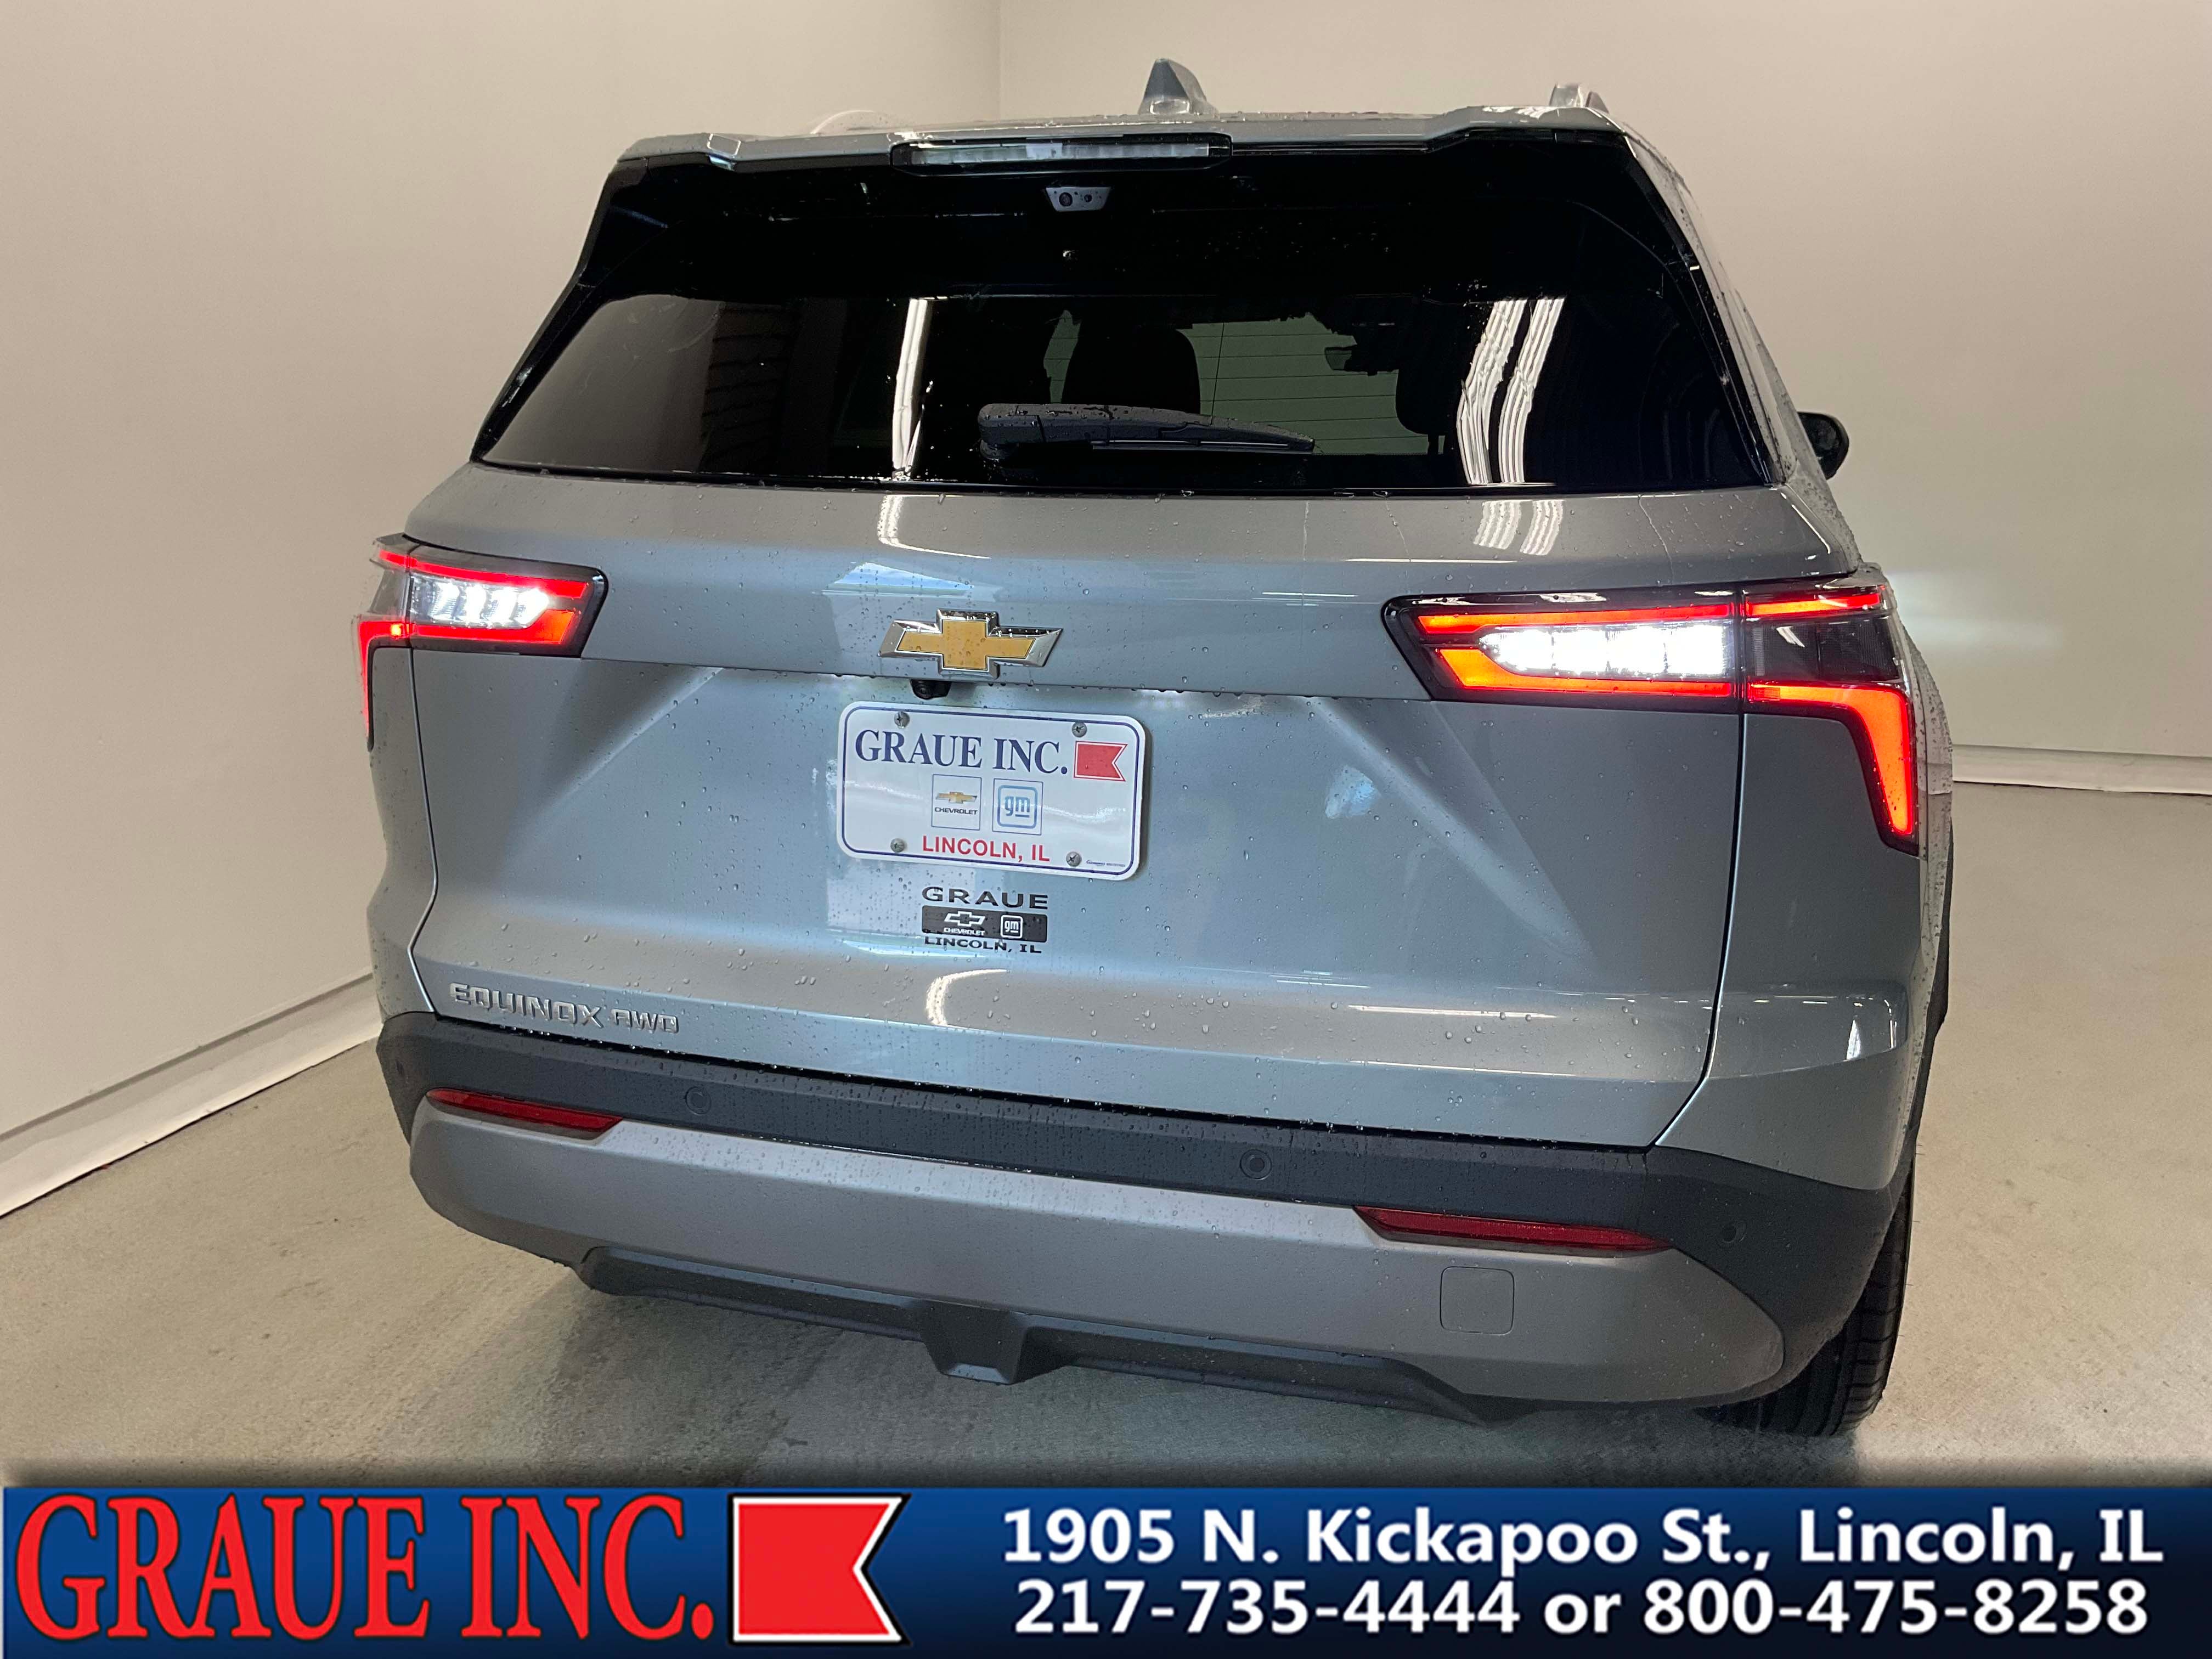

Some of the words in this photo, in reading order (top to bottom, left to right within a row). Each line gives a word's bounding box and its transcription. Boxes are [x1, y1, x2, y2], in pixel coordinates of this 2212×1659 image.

[855, 730, 982, 768] GRAUE
[992, 738, 1068, 774] INC.
[934, 807, 978, 815] CHEVROLET
[1005, 796, 1030, 817] gm
[922, 836, 1023, 862] LINCOLN,
[1031, 844, 1050, 862] IL
[922, 886, 1048, 910] GRAUE
[943, 927, 985, 936] CHEVROLET
[1004, 921, 1019, 933] gm
[924, 936, 1012, 952] LINCOLN,
[1019, 944, 1042, 953] IL
[450, 983, 605, 1028] EQUINOX
[611, 1008, 680, 1034] AWD
